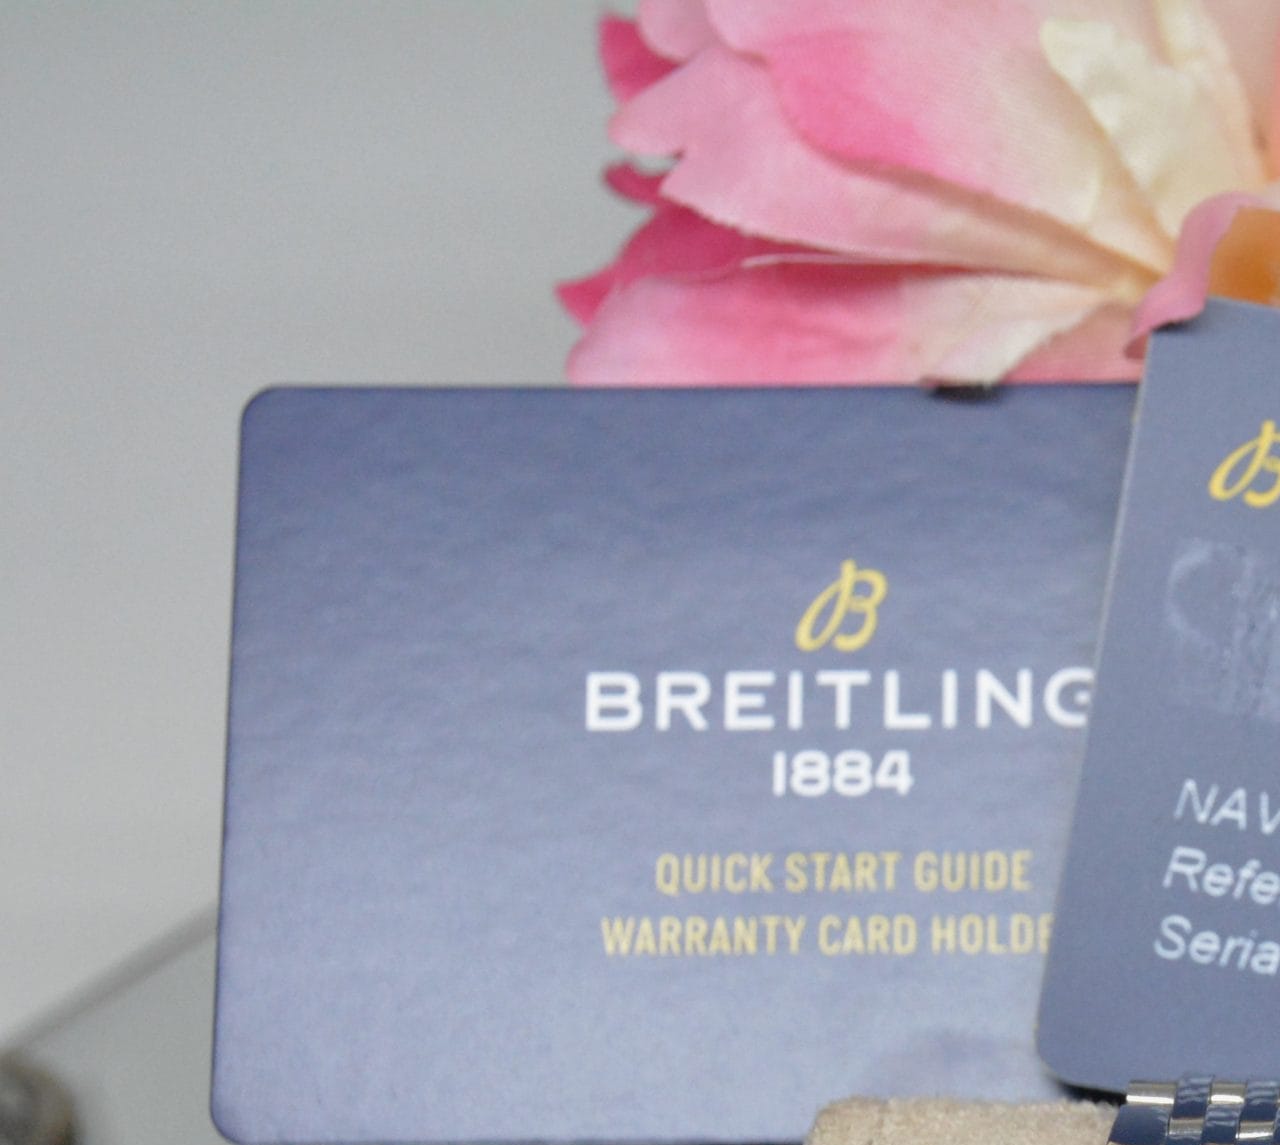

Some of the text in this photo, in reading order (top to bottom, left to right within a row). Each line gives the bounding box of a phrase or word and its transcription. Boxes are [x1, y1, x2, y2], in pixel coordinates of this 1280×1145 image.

[772, 749, 914, 797] 1884
[655, 849, 1033, 896] QUICK START GUIDE
[600, 914, 806, 957] WARRANTY
[817, 913, 919, 956] CARD
